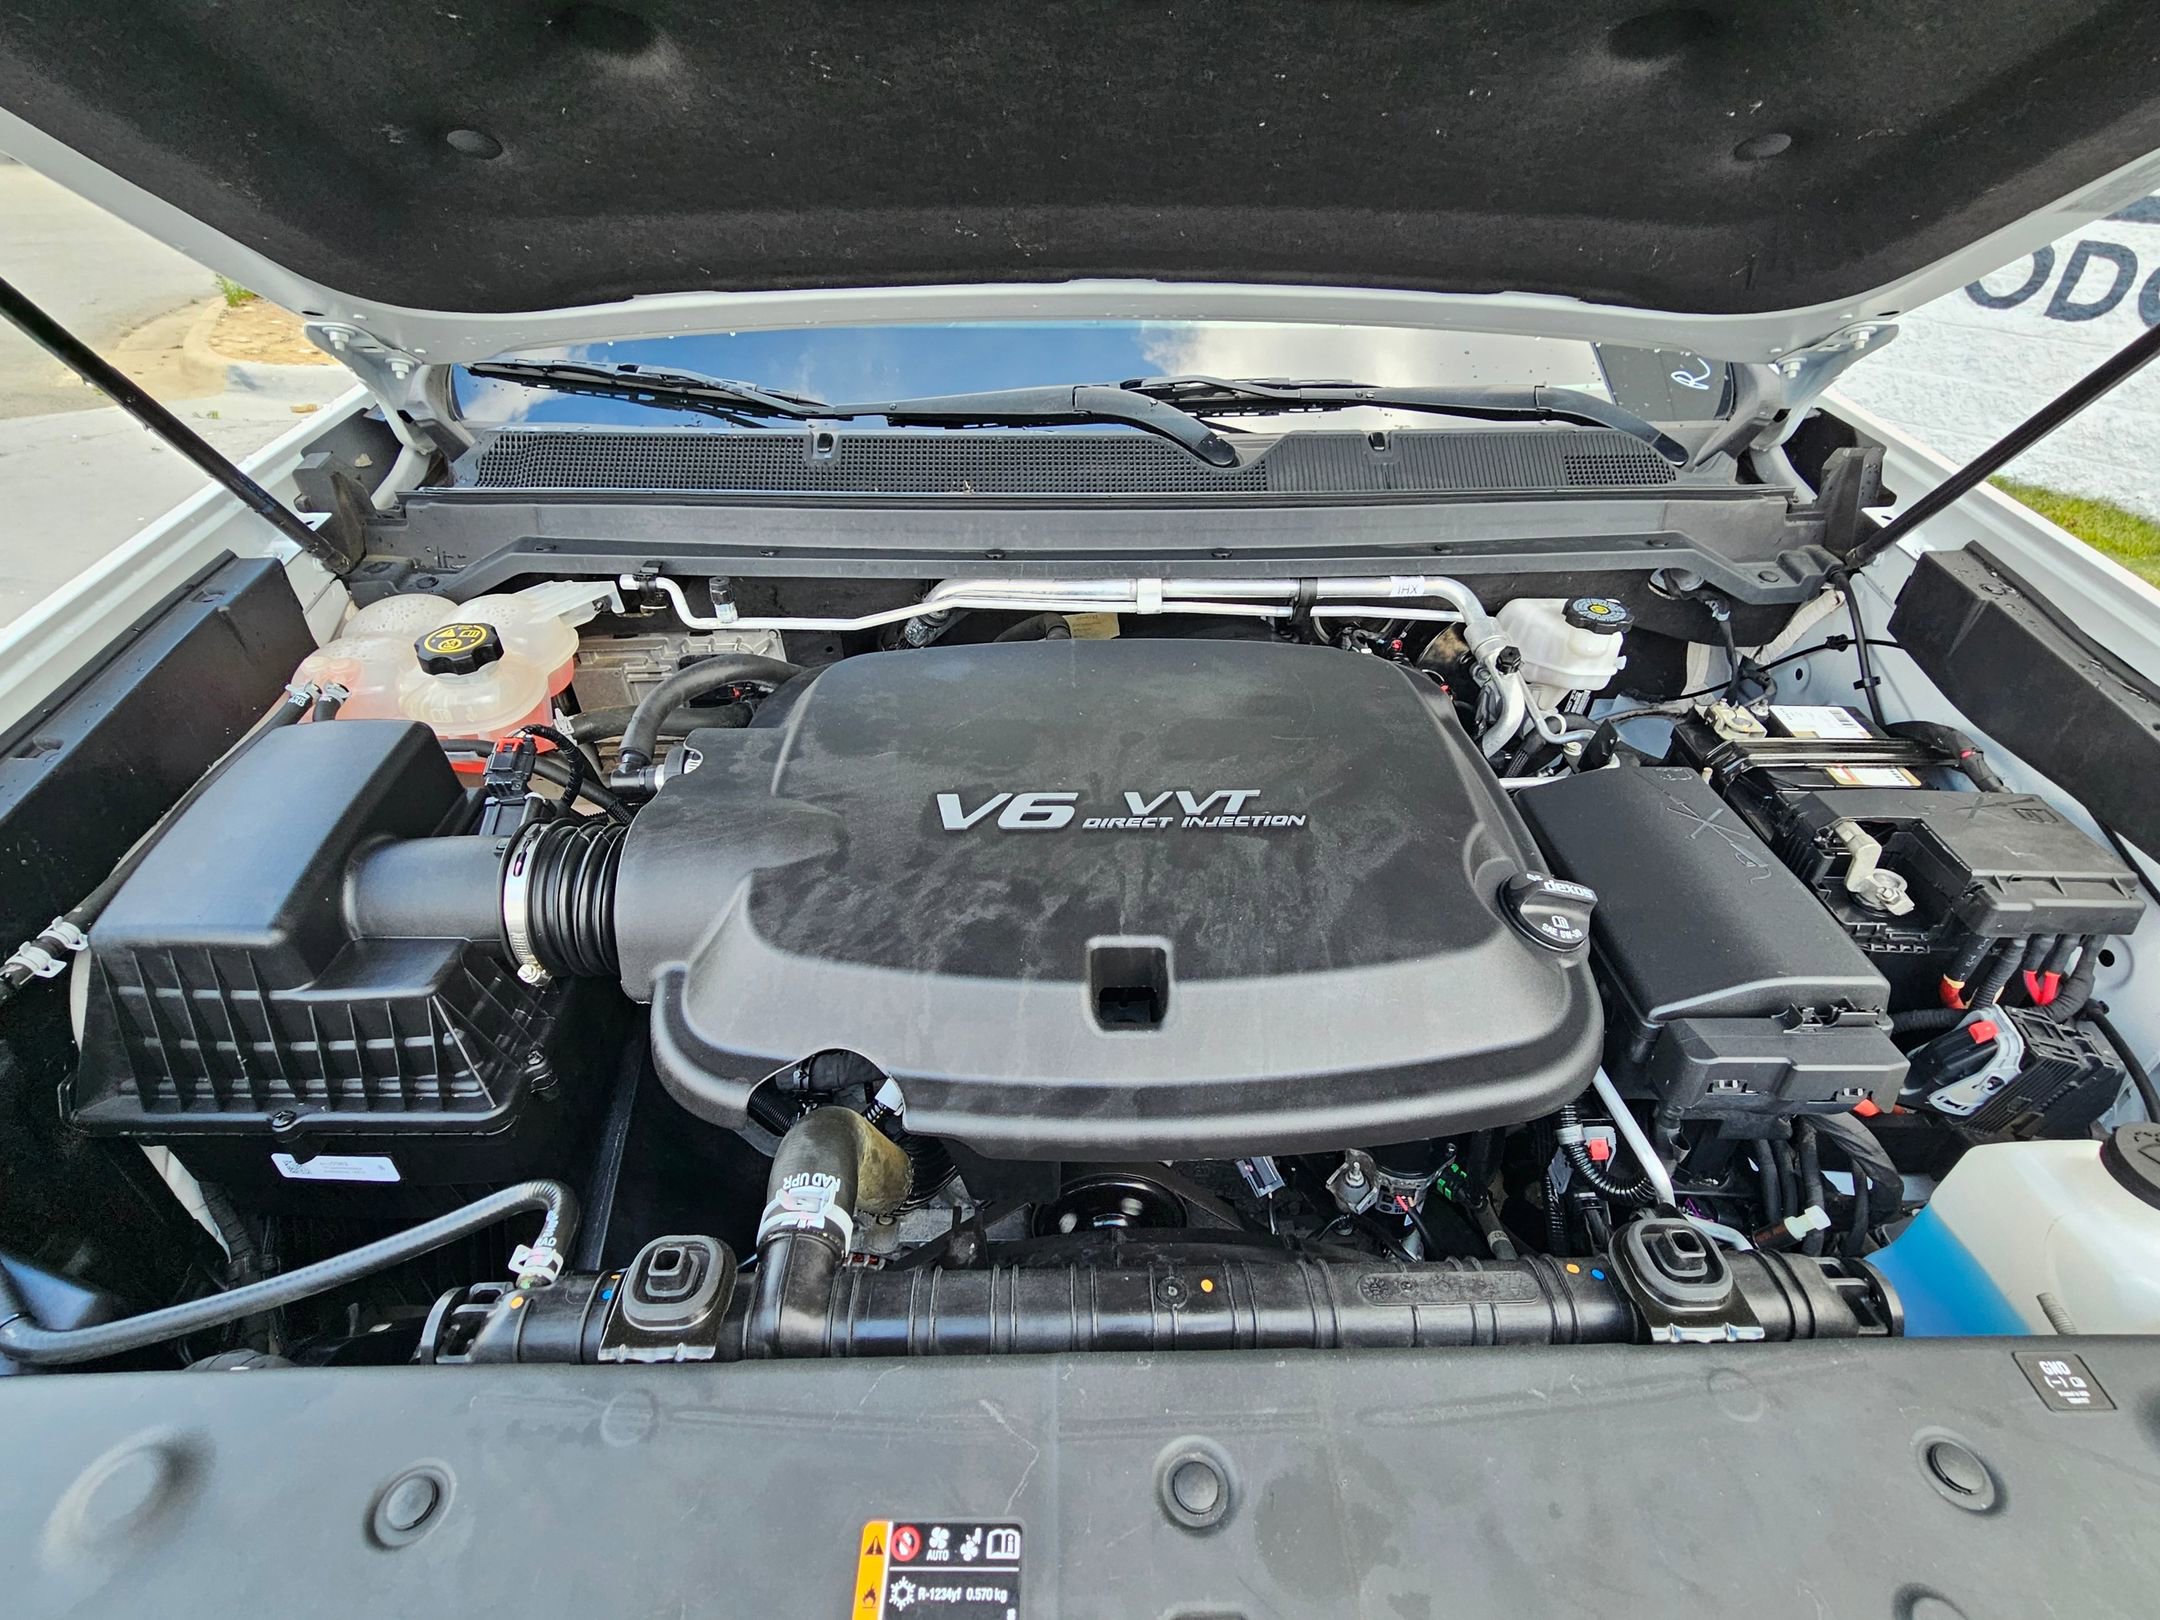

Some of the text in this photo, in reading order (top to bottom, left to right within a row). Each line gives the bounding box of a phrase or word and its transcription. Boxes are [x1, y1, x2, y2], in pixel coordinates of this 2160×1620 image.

[936, 792, 1079, 830] V6
[1123, 789, 1261, 816] VVT
[1081, 814, 1306, 829] DIRECT INJECTION
[1543, 880, 1594, 899] dexos
[1541, 922, 1559, 936] SAE
[782, 1172, 810, 1190] UPR
[2038, 1360, 2072, 1376] GND
[926, 1549, 950, 1562] AUTO
[917, 1587, 1008, 1604] R-1234yf 0.570 kg
